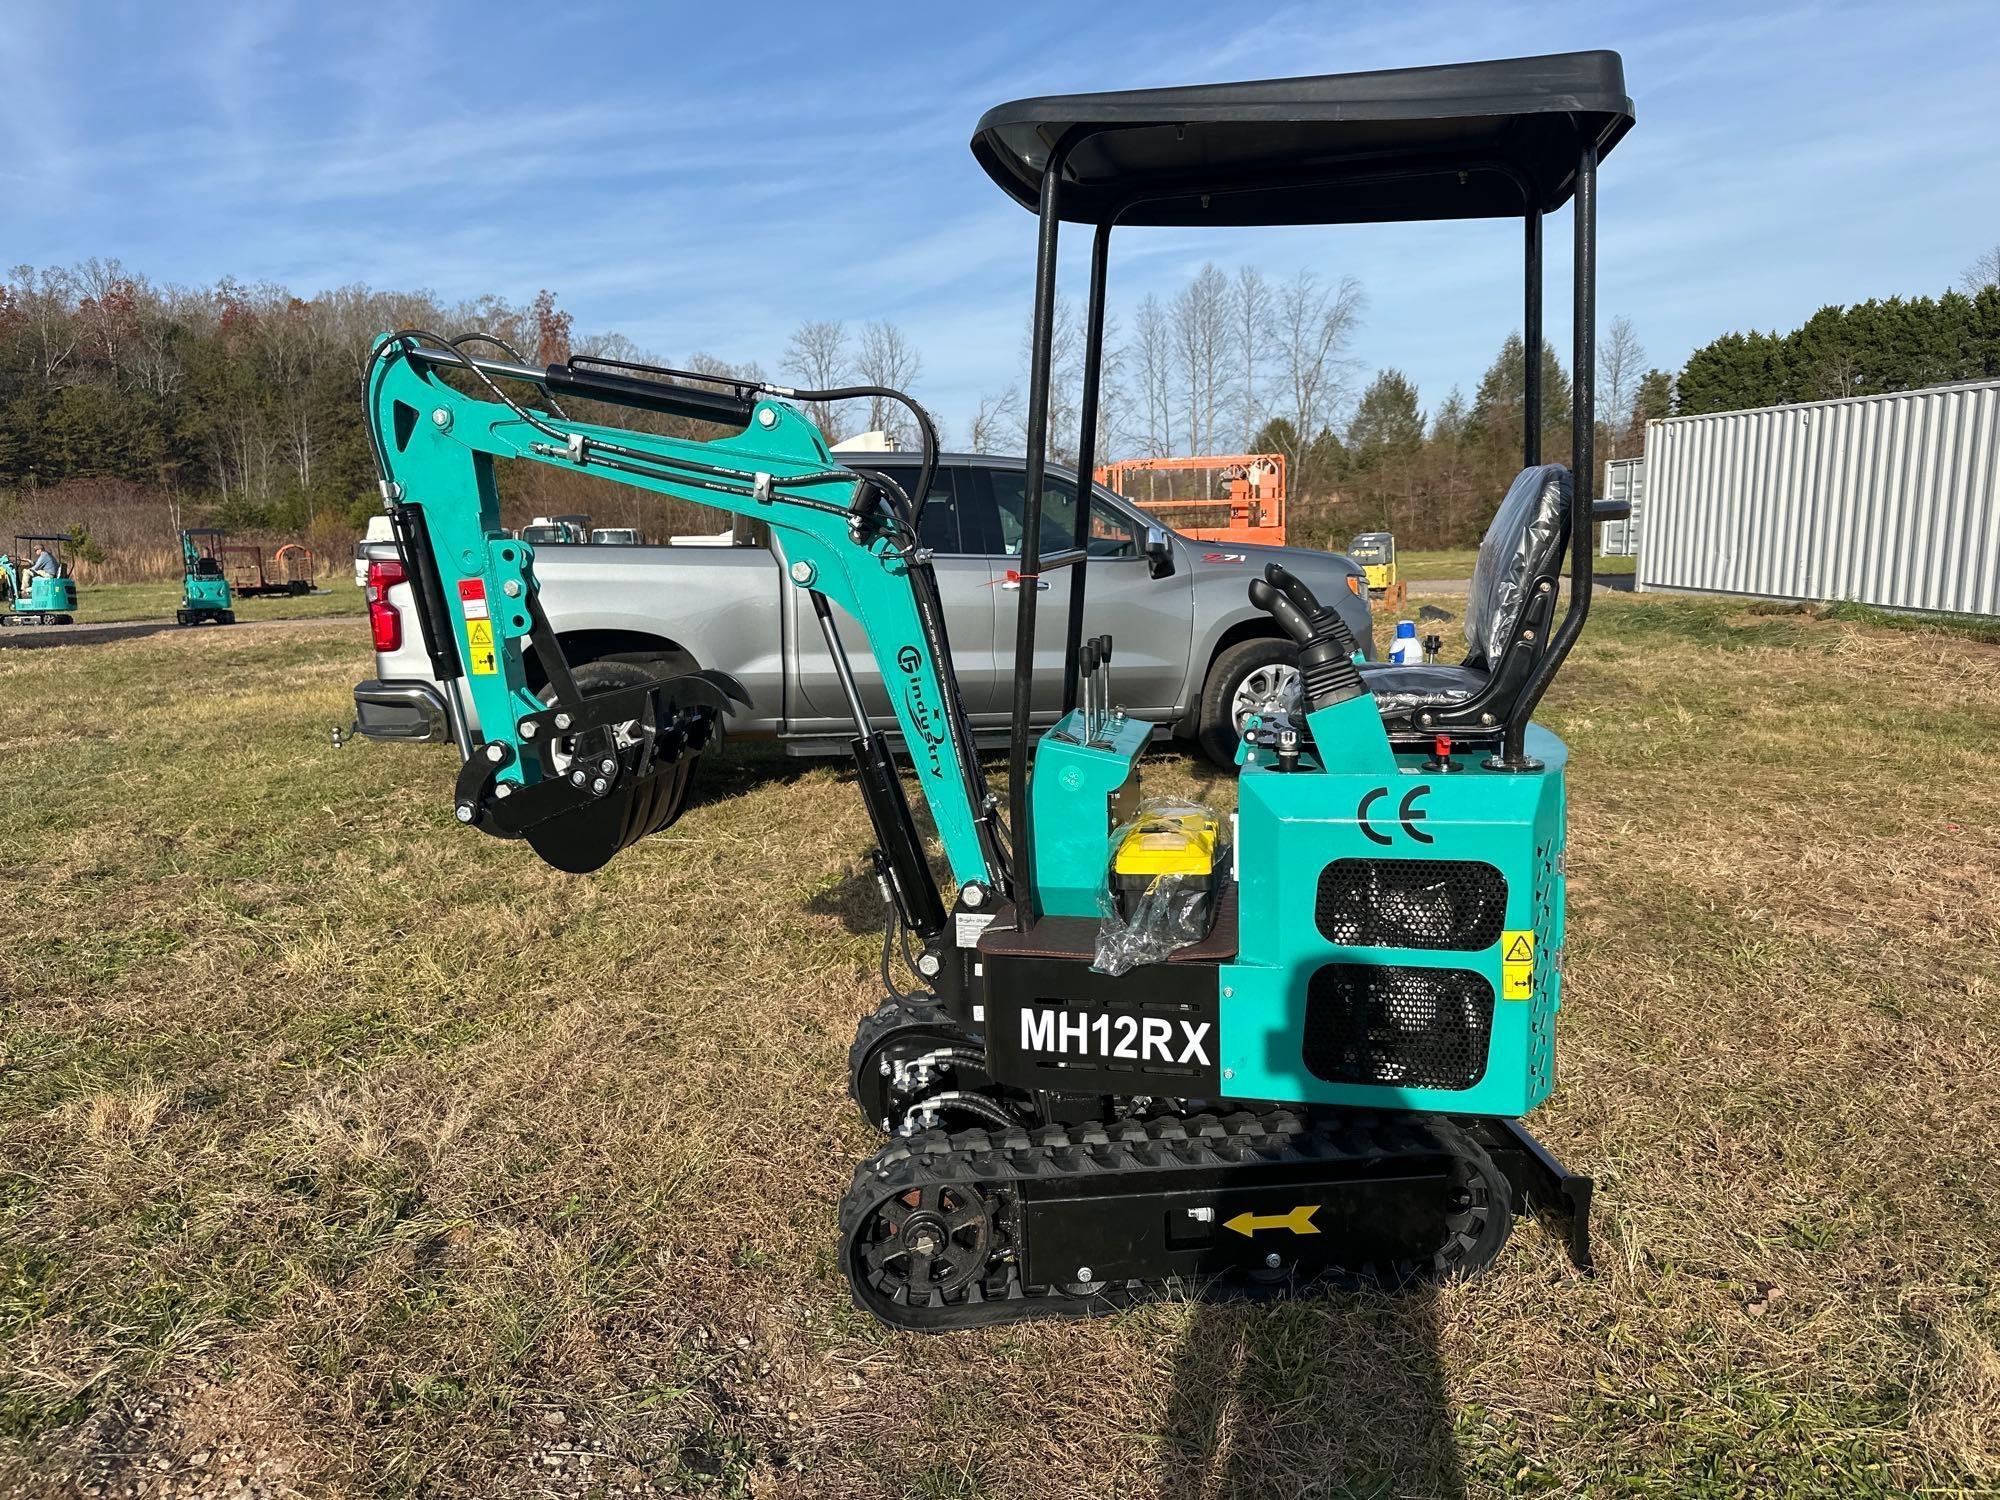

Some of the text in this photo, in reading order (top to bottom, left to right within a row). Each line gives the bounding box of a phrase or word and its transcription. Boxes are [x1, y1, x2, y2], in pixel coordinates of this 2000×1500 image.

[1202, 552, 1246, 563] Z71
[1357, 784, 1434, 846] CE
[1020, 1007, 1211, 1066] MH12RX
